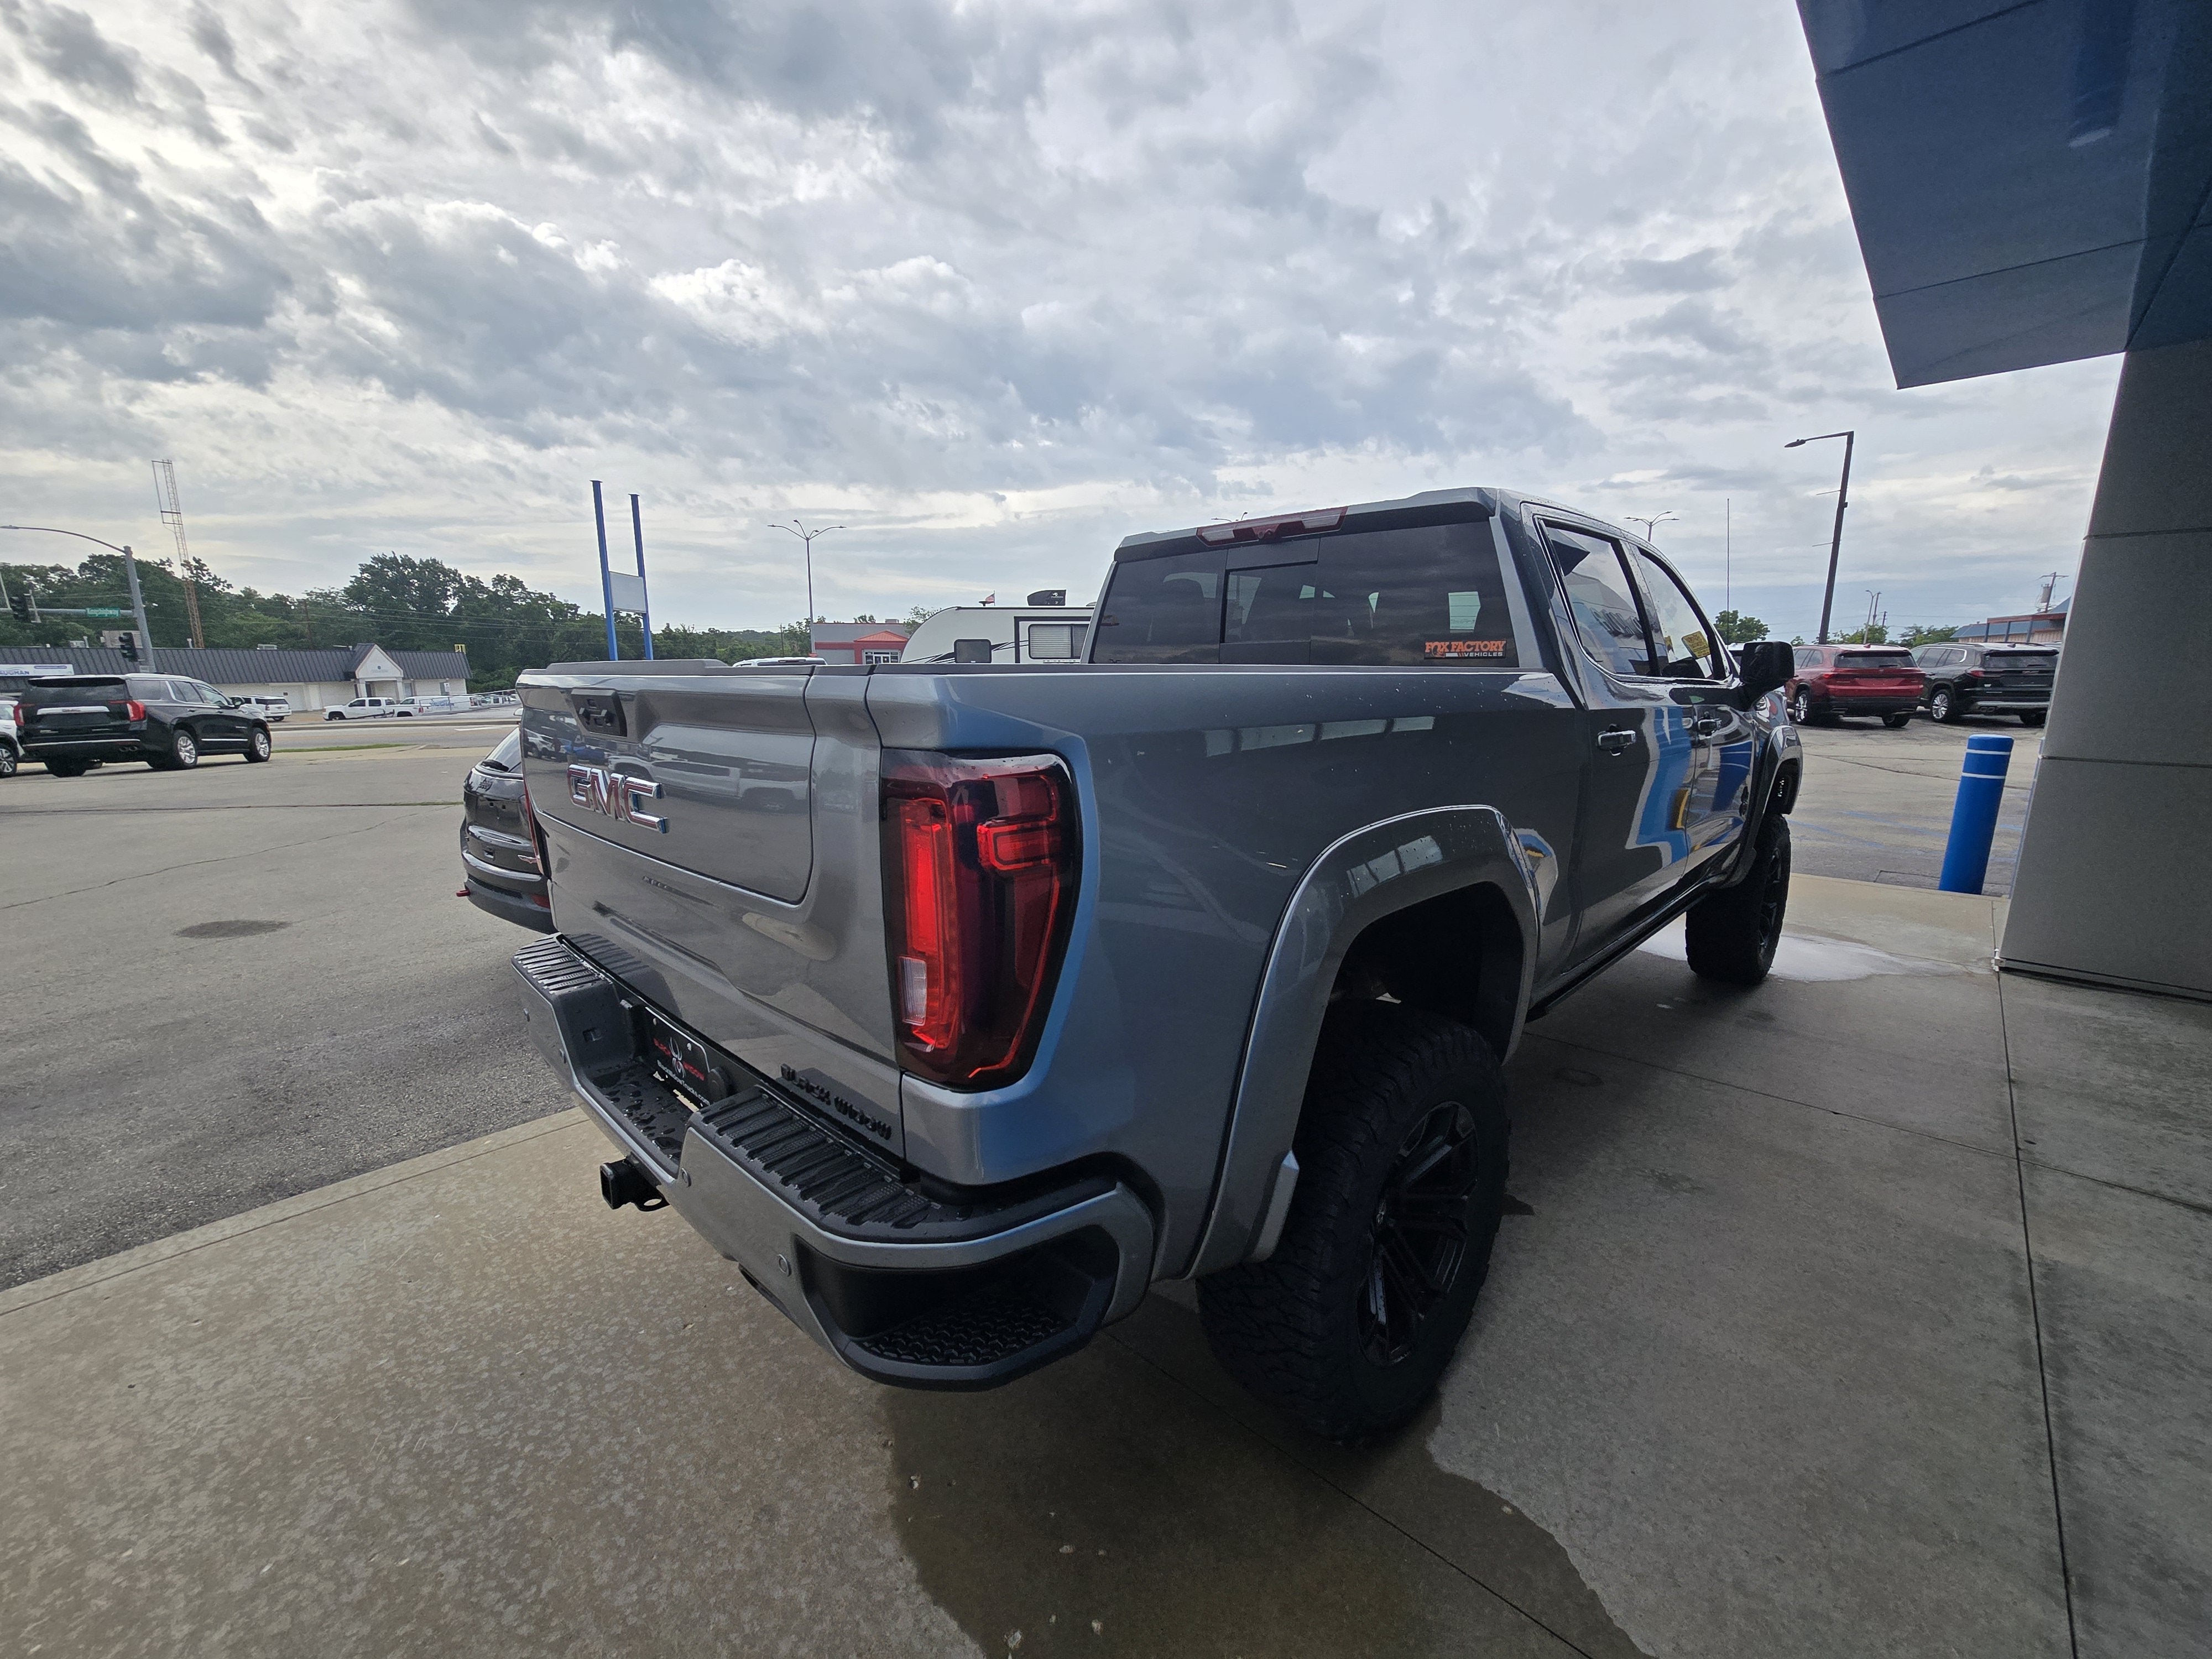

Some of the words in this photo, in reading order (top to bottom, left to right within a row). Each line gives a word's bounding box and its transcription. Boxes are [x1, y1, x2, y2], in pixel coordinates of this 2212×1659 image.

[1425, 641, 1449, 658] FOX
[1451, 641, 1506, 652] FACTORY
[567, 764, 669, 834] GMC
[780, 1063, 832, 1106] BLACK
[834, 1096, 892, 1140] WIDOW
